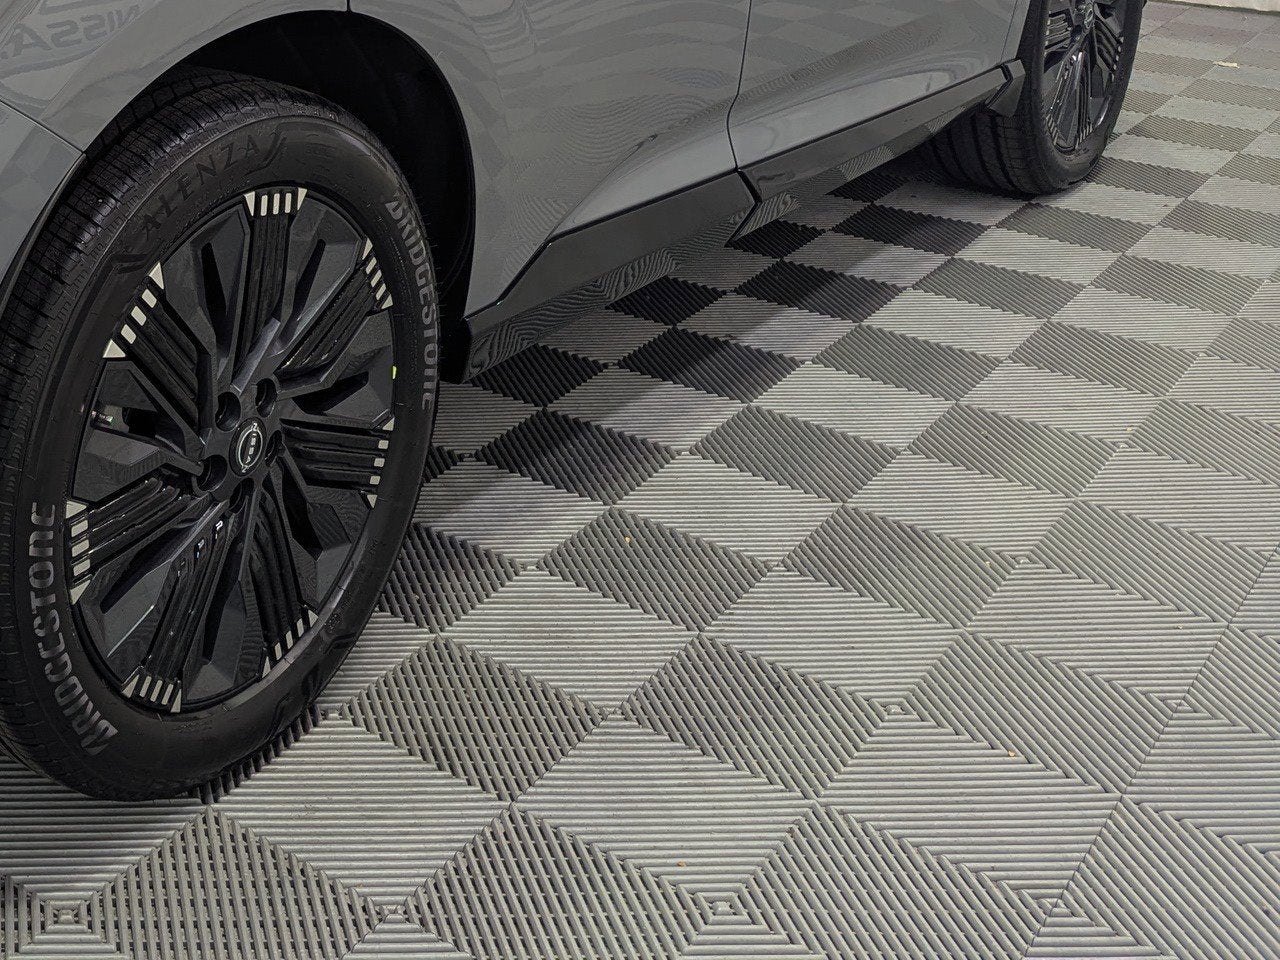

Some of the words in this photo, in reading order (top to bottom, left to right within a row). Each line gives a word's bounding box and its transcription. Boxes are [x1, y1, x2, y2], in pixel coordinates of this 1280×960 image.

[141, 134, 261, 241] ALENZA
[385, 200, 439, 411] BRIDGESTONE
[28, 502, 119, 755] BRIDGESTONE
